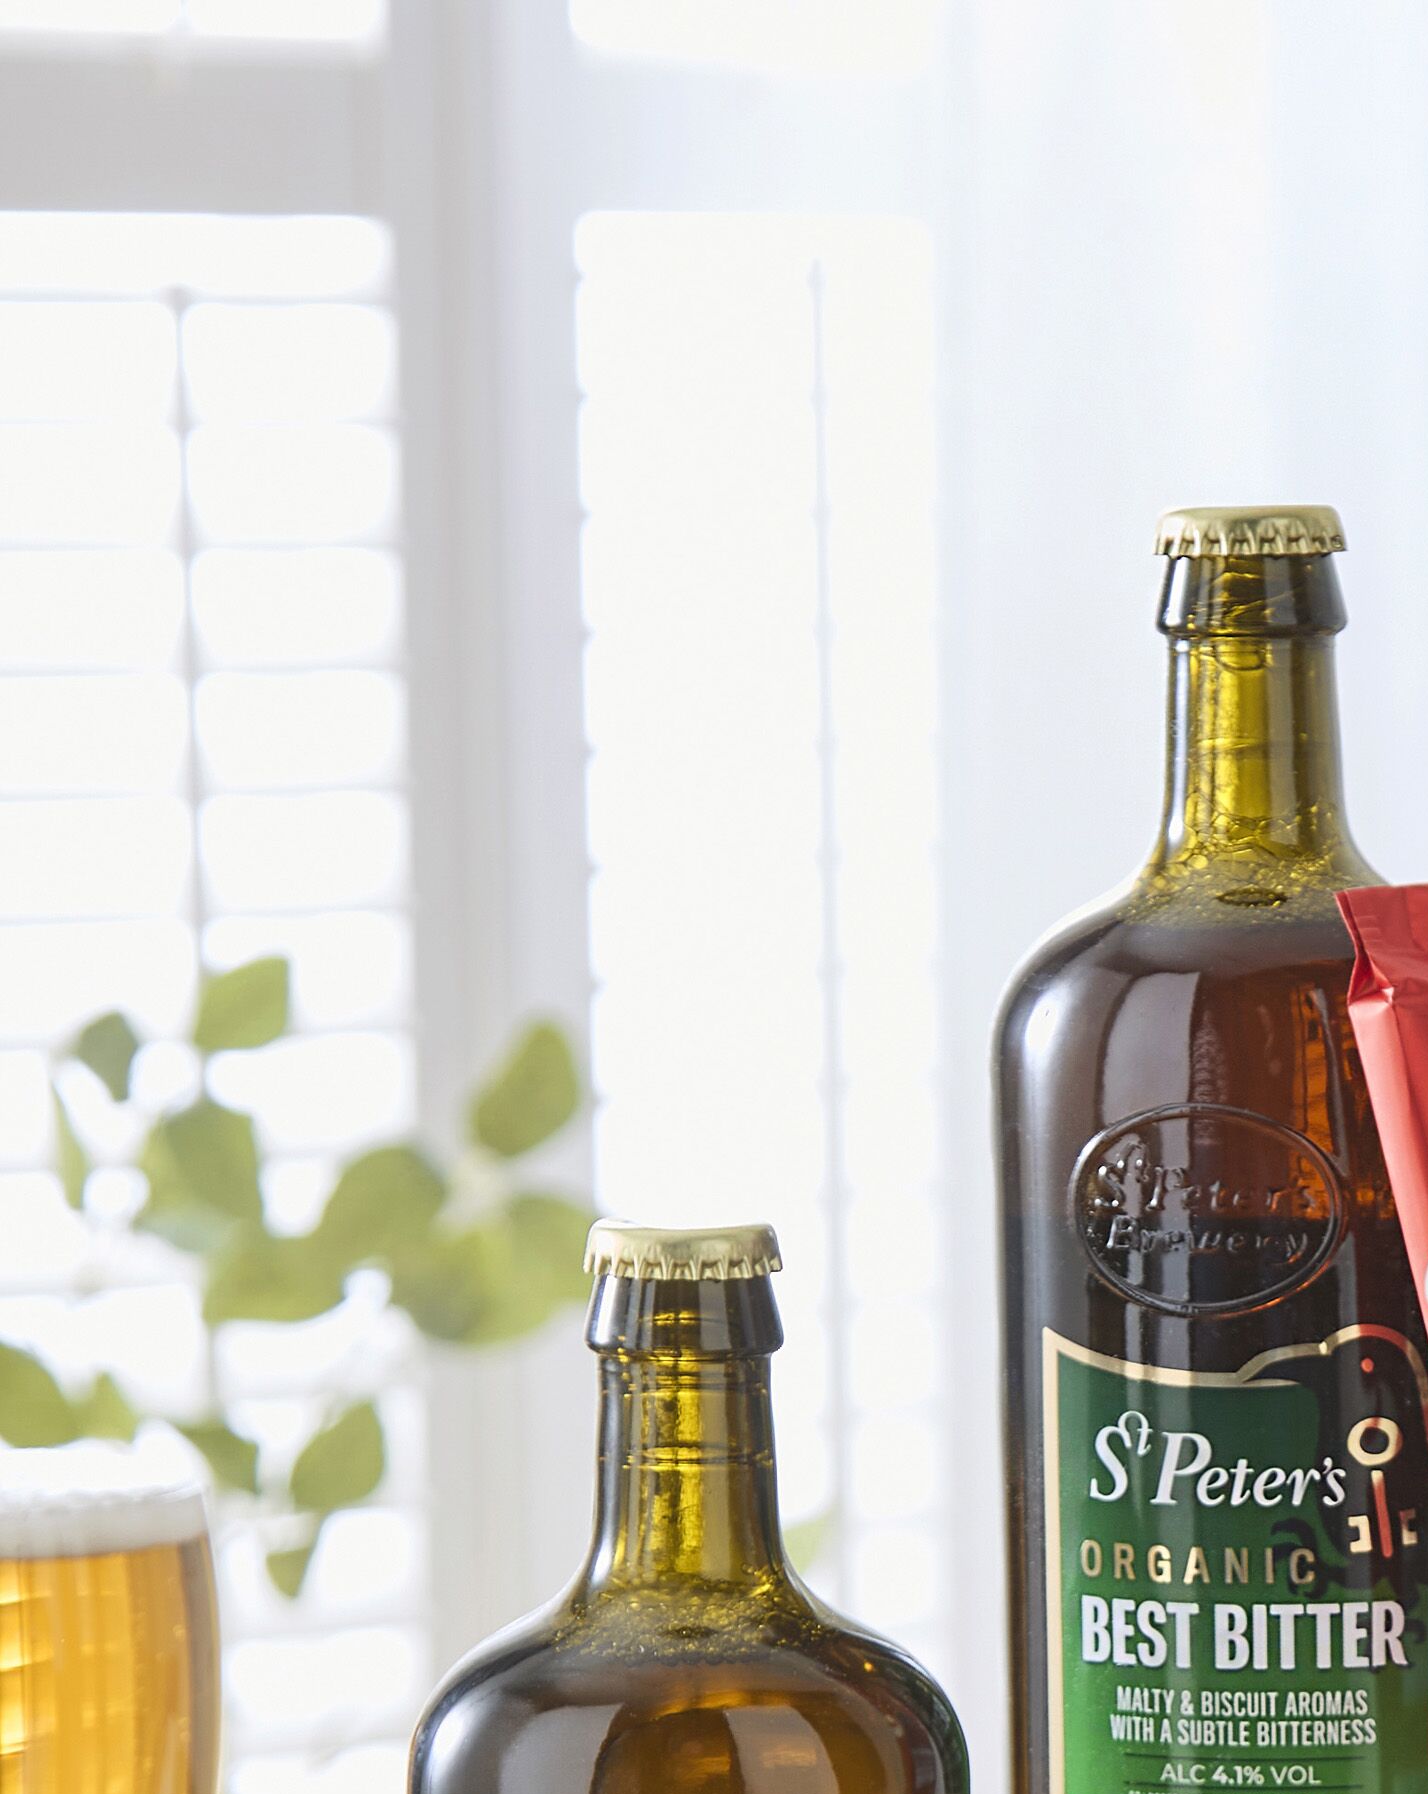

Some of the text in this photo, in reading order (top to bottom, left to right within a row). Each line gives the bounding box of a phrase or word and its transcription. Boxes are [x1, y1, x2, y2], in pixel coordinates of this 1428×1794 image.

[1089, 1410, 1346, 1507] St Peter's
[1080, 1539, 1316, 1585] ORGANIC
[1080, 1594, 1409, 1670] BEST BITTER
[1116, 1686, 1368, 1717] MALTY & BISCUIT AROMAS
[1110, 1714, 1377, 1746] WITH A SUBTLE BITTERNESS
[1161, 1763, 1321, 1785] ALC 4.1% VOL
